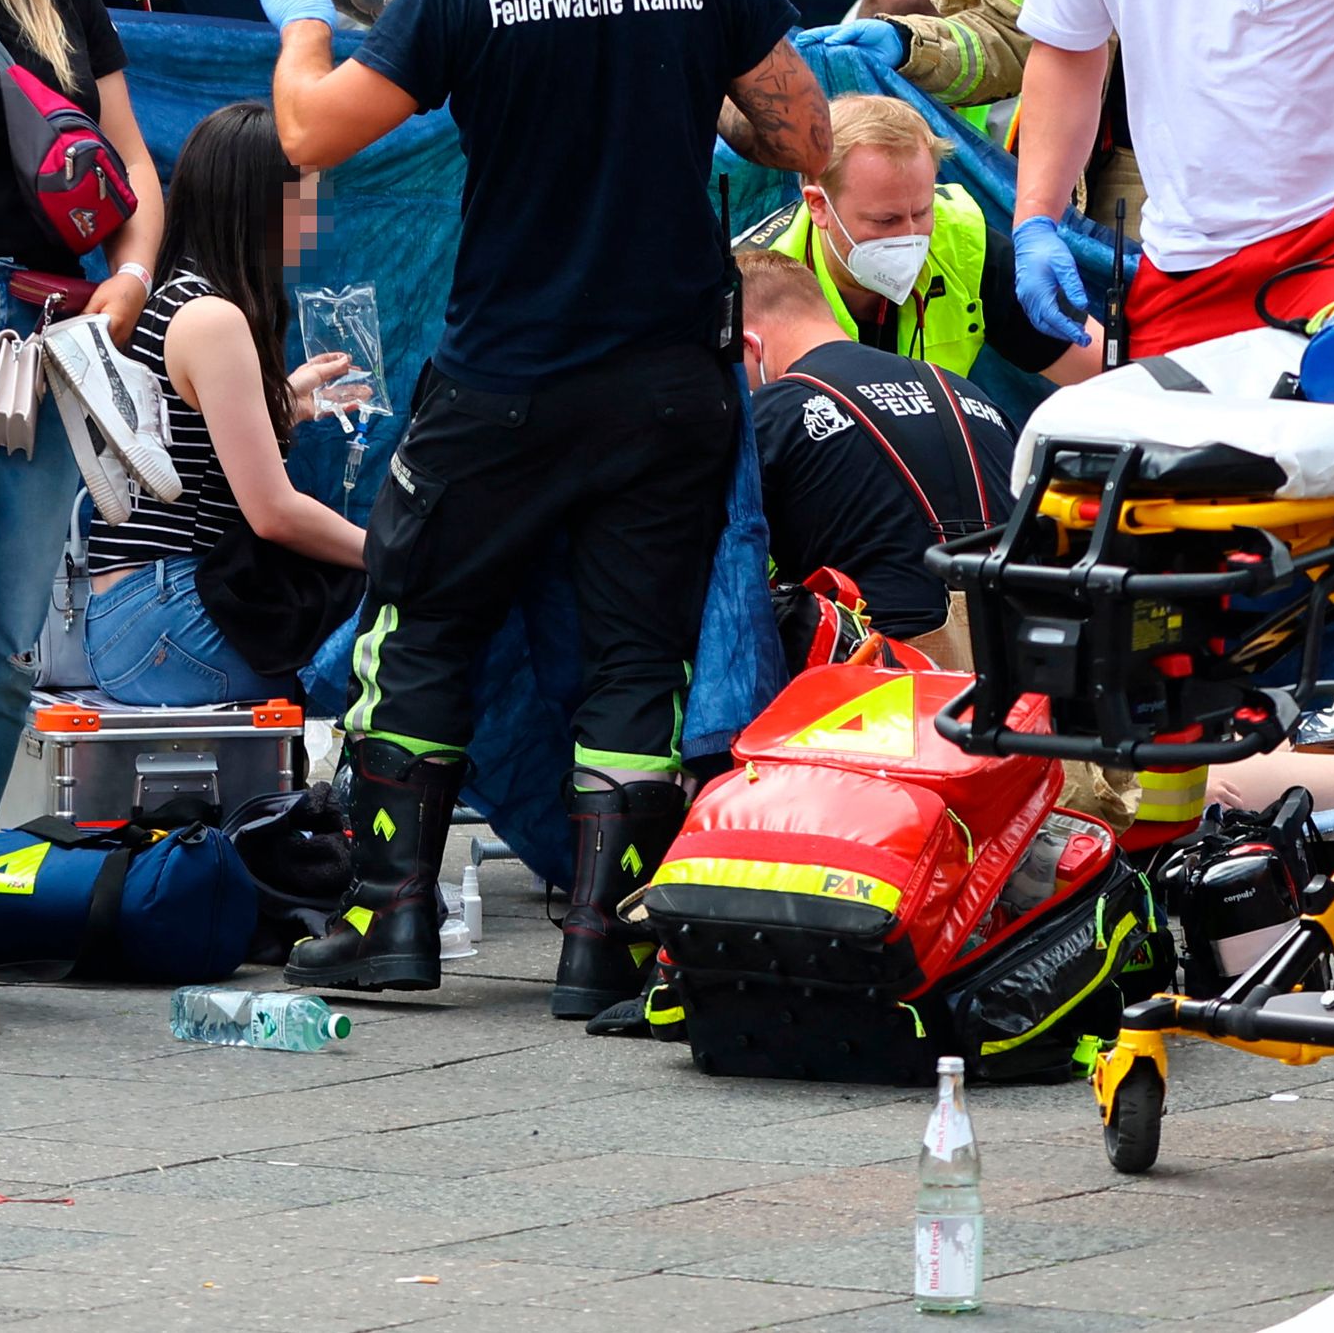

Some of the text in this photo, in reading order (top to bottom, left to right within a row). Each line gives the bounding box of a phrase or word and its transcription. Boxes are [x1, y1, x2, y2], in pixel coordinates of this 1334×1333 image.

[822, 873, 873, 900] PAX
[929, 1220, 941, 1291] Black Forest
